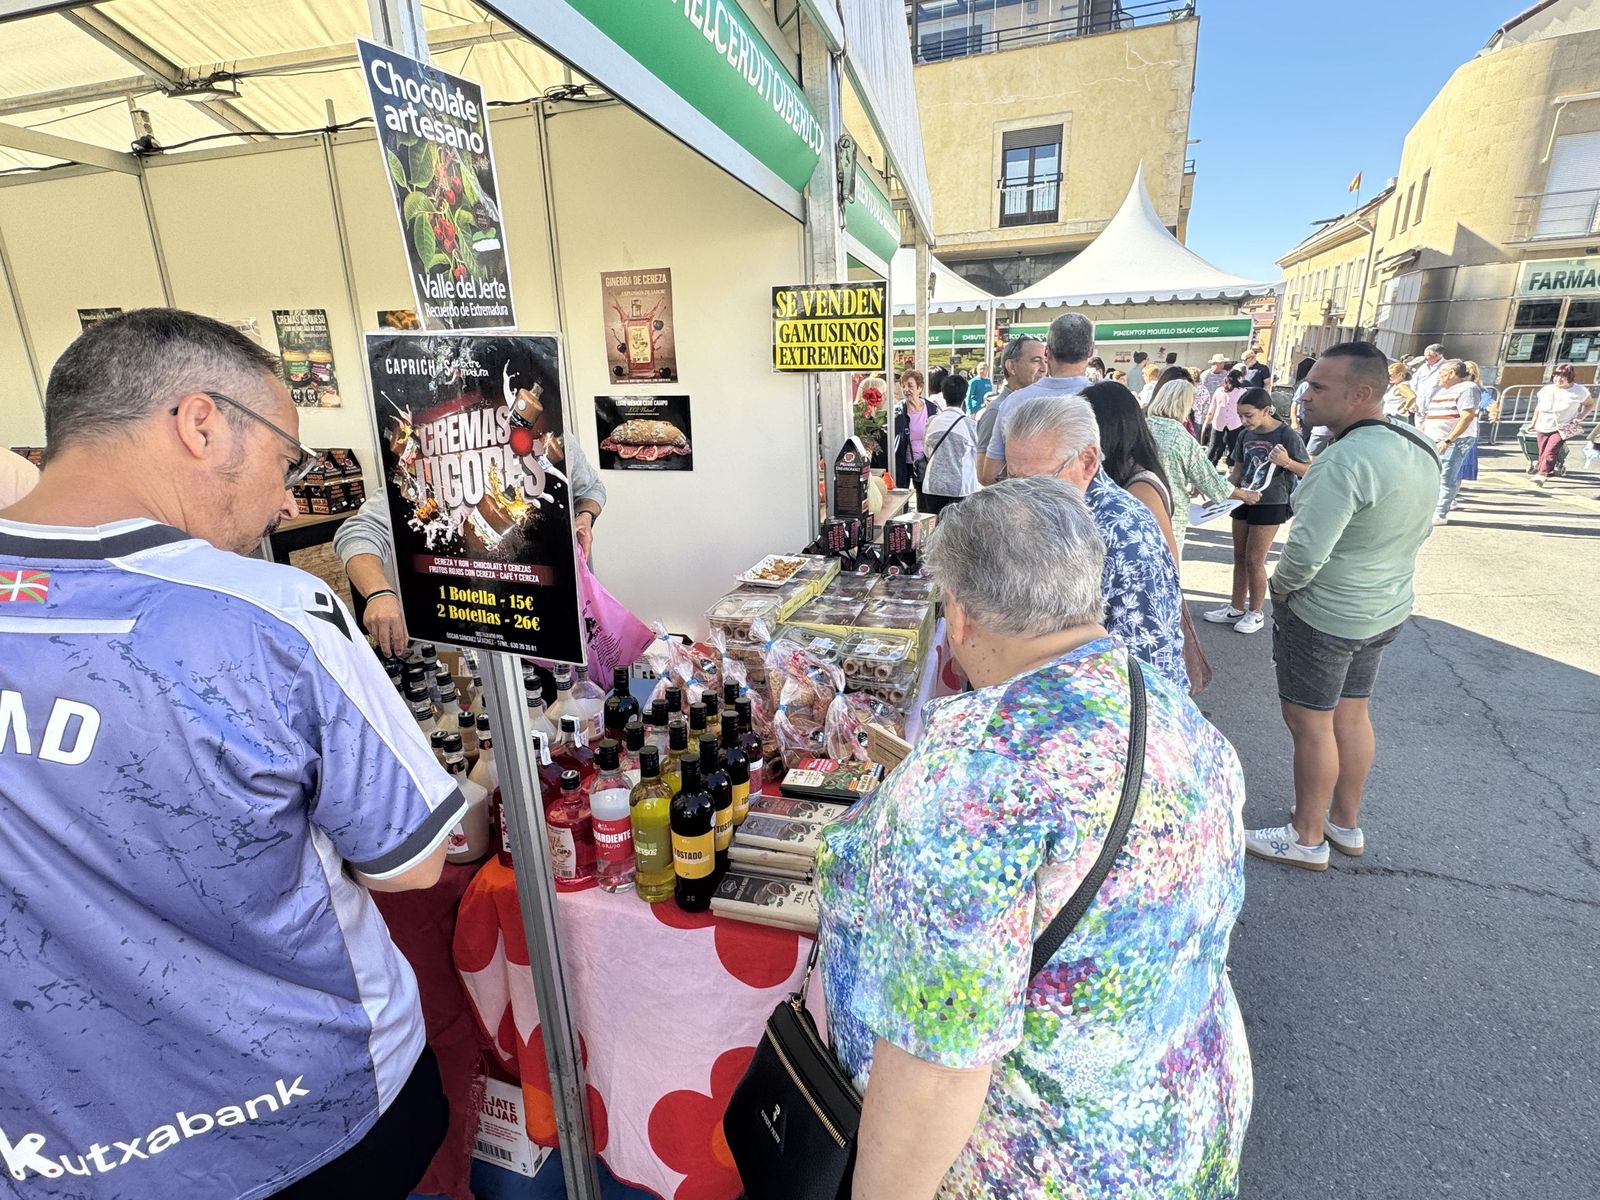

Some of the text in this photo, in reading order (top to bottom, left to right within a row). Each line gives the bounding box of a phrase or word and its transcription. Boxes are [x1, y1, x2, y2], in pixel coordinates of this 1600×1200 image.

[371, 59, 478, 123] Chocolate
[384, 102, 484, 154] artesano
[418, 273, 507, 299] Valle del Jerte
[605, 273, 667, 287] GINEBRA DE CEREZA
[1529, 269, 1600, 291] FARMA
[424, 301, 508, 318] Recuerdo de Extremadura
[776, 288, 884, 318] SE VENDEN
[276, 315, 301, 325] CREMAS
[308, 315, 326, 324] QUESO
[1113, 325, 1220, 337] PIMIENTOS PIQUILLO ISAAC GÓMEZ
[779, 322, 880, 344] GAMUSINOS
[779, 343, 879, 366] EXTREMEÑOS
[420, 405, 511, 456] CREMAS
[428, 565, 448, 574] FRUTOS
[448, 567, 464, 576] ROJOS
[464, 568, 475, 576] CON
[475, 569, 496, 579] CEREZA
[499, 571, 514, 581] CAFÉ
[518, 573, 540, 583] CEREZA
[433, 557, 454, 566] CEREZA
[453, 559, 458, 567] Y
[458, 560, 469, 568] RON
[473, 561, 503, 571] CHOCOLATE
[502, 563, 508, 571] Y
[508, 564, 532, 573] CEREZAS
[439, 585, 446, 599] 1
[449, 586, 497, 606] Botella
[509, 594, 534, 611] 15€
[436, 603, 446, 617] 2
[448, 604, 501, 626] Botellas
[513, 614, 541, 631] 26€
[674, 846, 703, 860] TOSTADO
